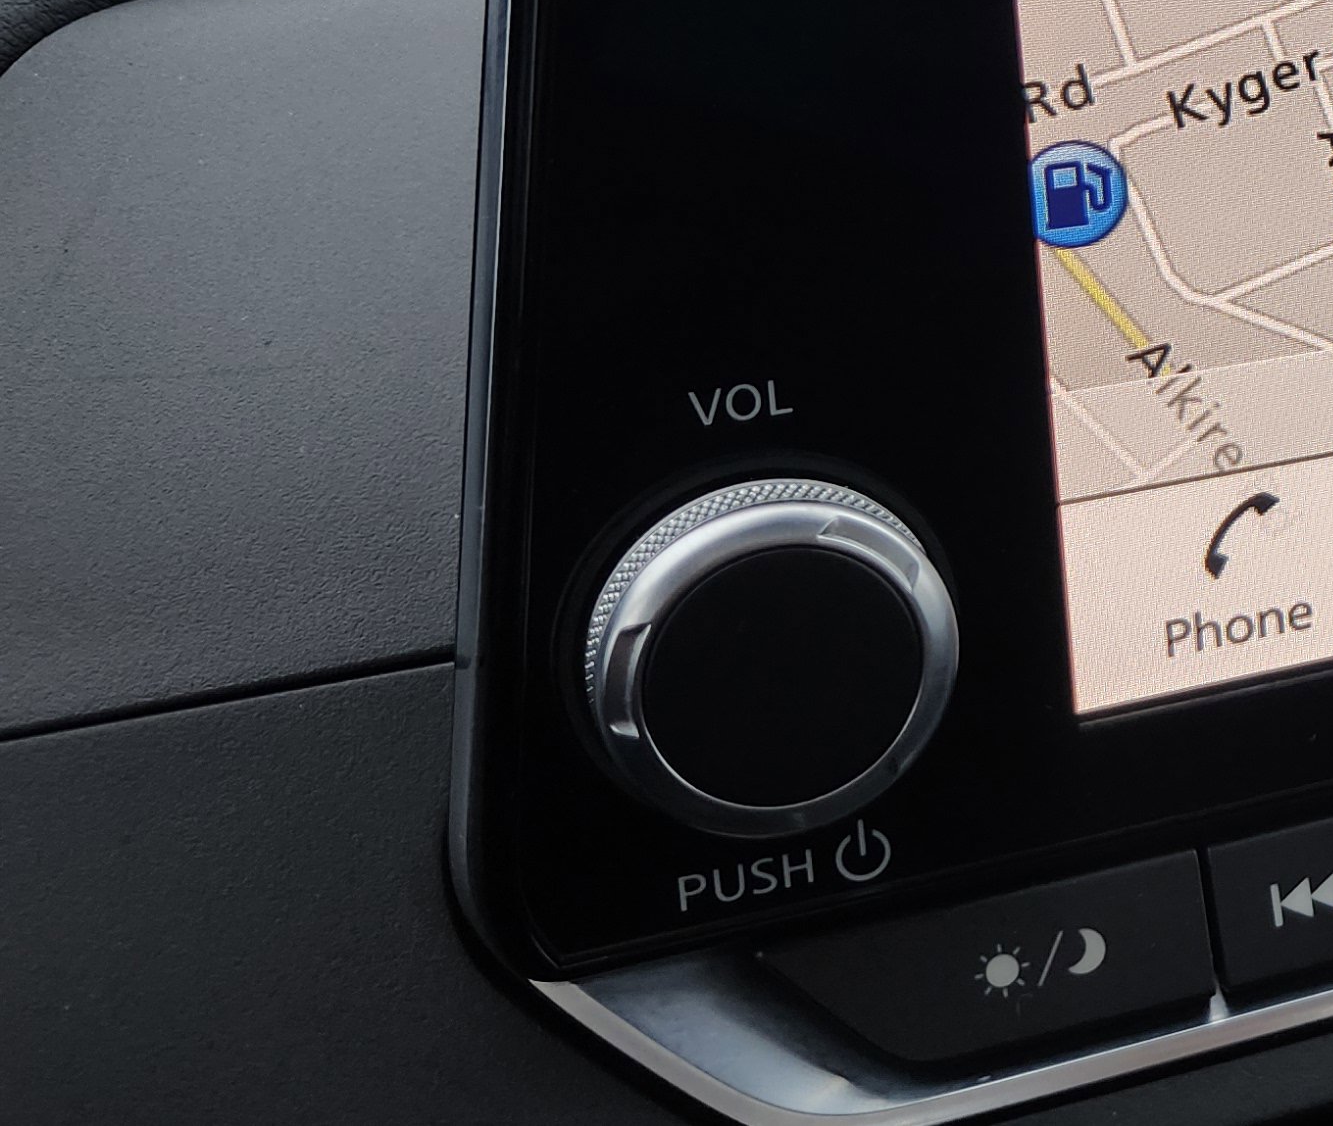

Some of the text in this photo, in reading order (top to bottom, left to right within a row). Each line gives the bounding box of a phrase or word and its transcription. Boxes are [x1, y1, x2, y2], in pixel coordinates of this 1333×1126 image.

[1023, 64, 1096, 123] Rd
[1164, 50, 1320, 131] Kyger
[688, 379, 793, 426] VOL
[1164, 597, 1314, 657] Phone
[677, 848, 816, 913] PUSH
